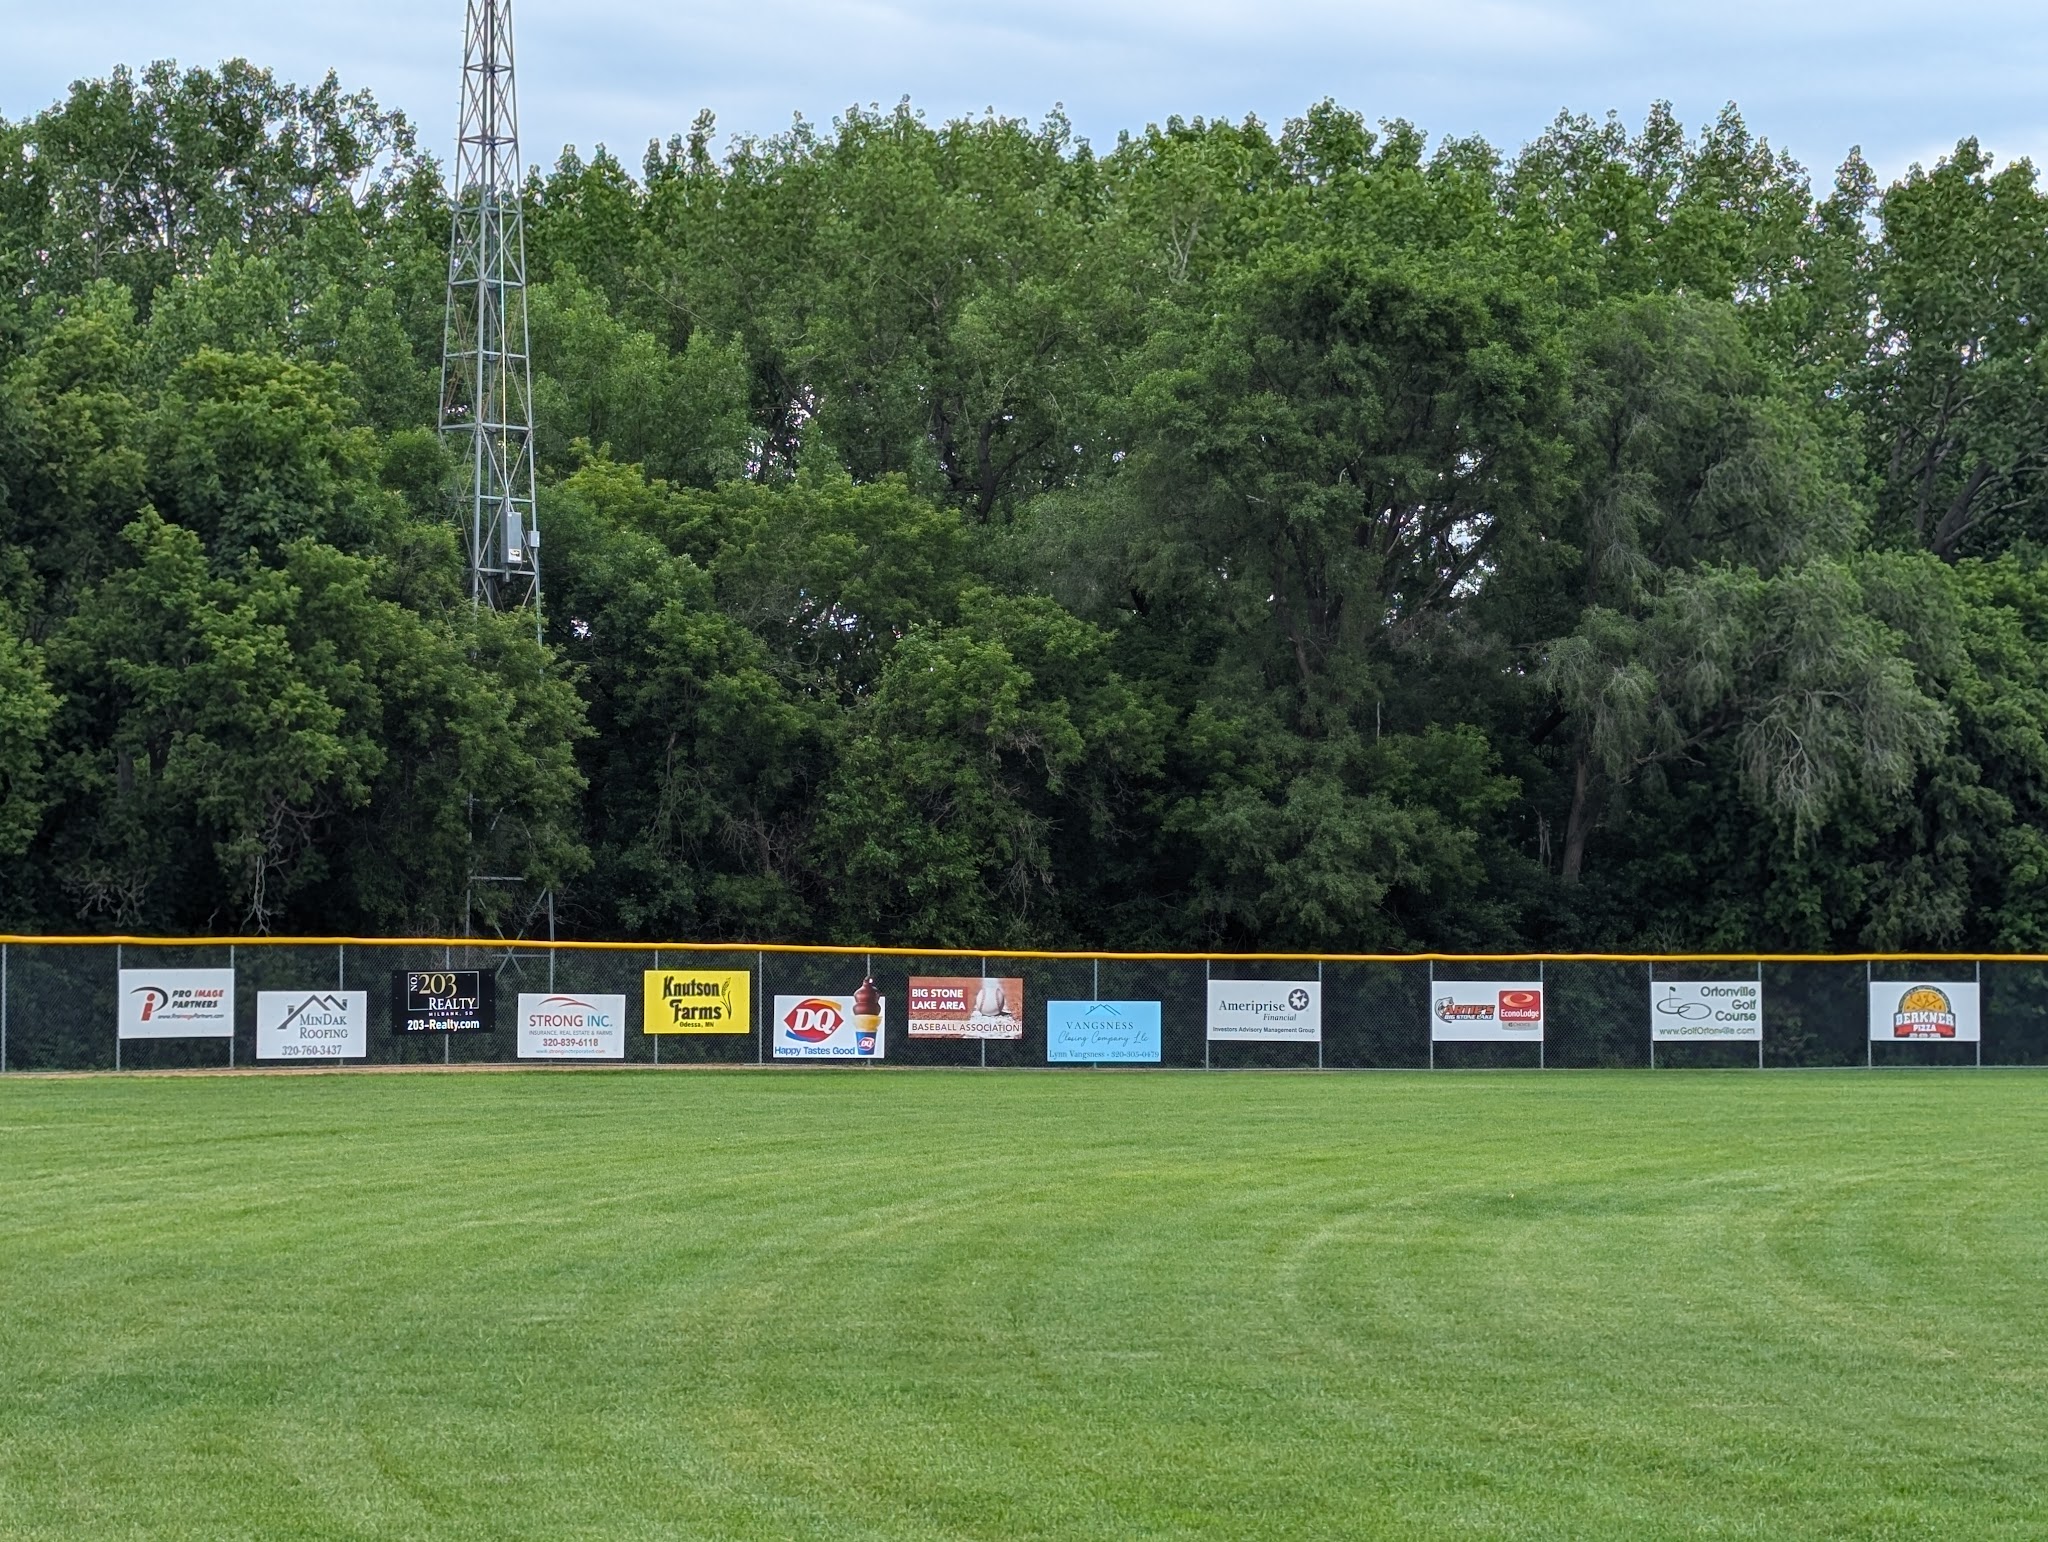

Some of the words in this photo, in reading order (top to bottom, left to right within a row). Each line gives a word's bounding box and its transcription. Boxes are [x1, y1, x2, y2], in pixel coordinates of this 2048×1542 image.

[410, 975, 418, 991] NO.
[419, 974, 457, 998] 203
[662, 975, 720, 1000] Knutson
[172, 990, 191, 998] PRO
[912, 989, 928, 998] BIG
[931, 989, 963, 998] STONE
[1701, 986, 1756, 997] Ortonville
[172, 1000, 218, 1008] PARTNERS
[912, 1001, 936, 1010] LAKE
[939, 1001, 966, 1010] AREA
[1219, 1000, 1285, 1014] Ameriprise
[1732, 999, 1756, 1010] Golf
[670, 999, 722, 1023] Farms
[1715, 1011, 1756, 1021] Course
[529, 1015, 583, 1027] STRONG
[588, 1015, 613, 1027] INC.
[793, 1009, 835, 1034] DQ
[1896, 1012, 1954, 1026] BERKNER
[408, 1019, 479, 1031] 203-Realty.com
[960, 1024, 1020, 1032] ASSOCIATION
[1066, 1022, 1134, 1030] VANGSNESS
[543, 1038, 599, 1046] 320-839-6118
[1058, 1031, 1087, 1047] Closing
[1092, 1031, 1130, 1047] Company
[282, 1045, 342, 1055] 320-760-3437
[860, 1041, 873, 1049] DQ
[775, 1047, 801, 1056] Happy
[803, 1047, 830, 1055] Tastes
[833, 1047, 855, 1055] Good
[1049, 1050, 1067, 1060] Lynn
[1069, 1050, 1105, 1060] Vangsness
